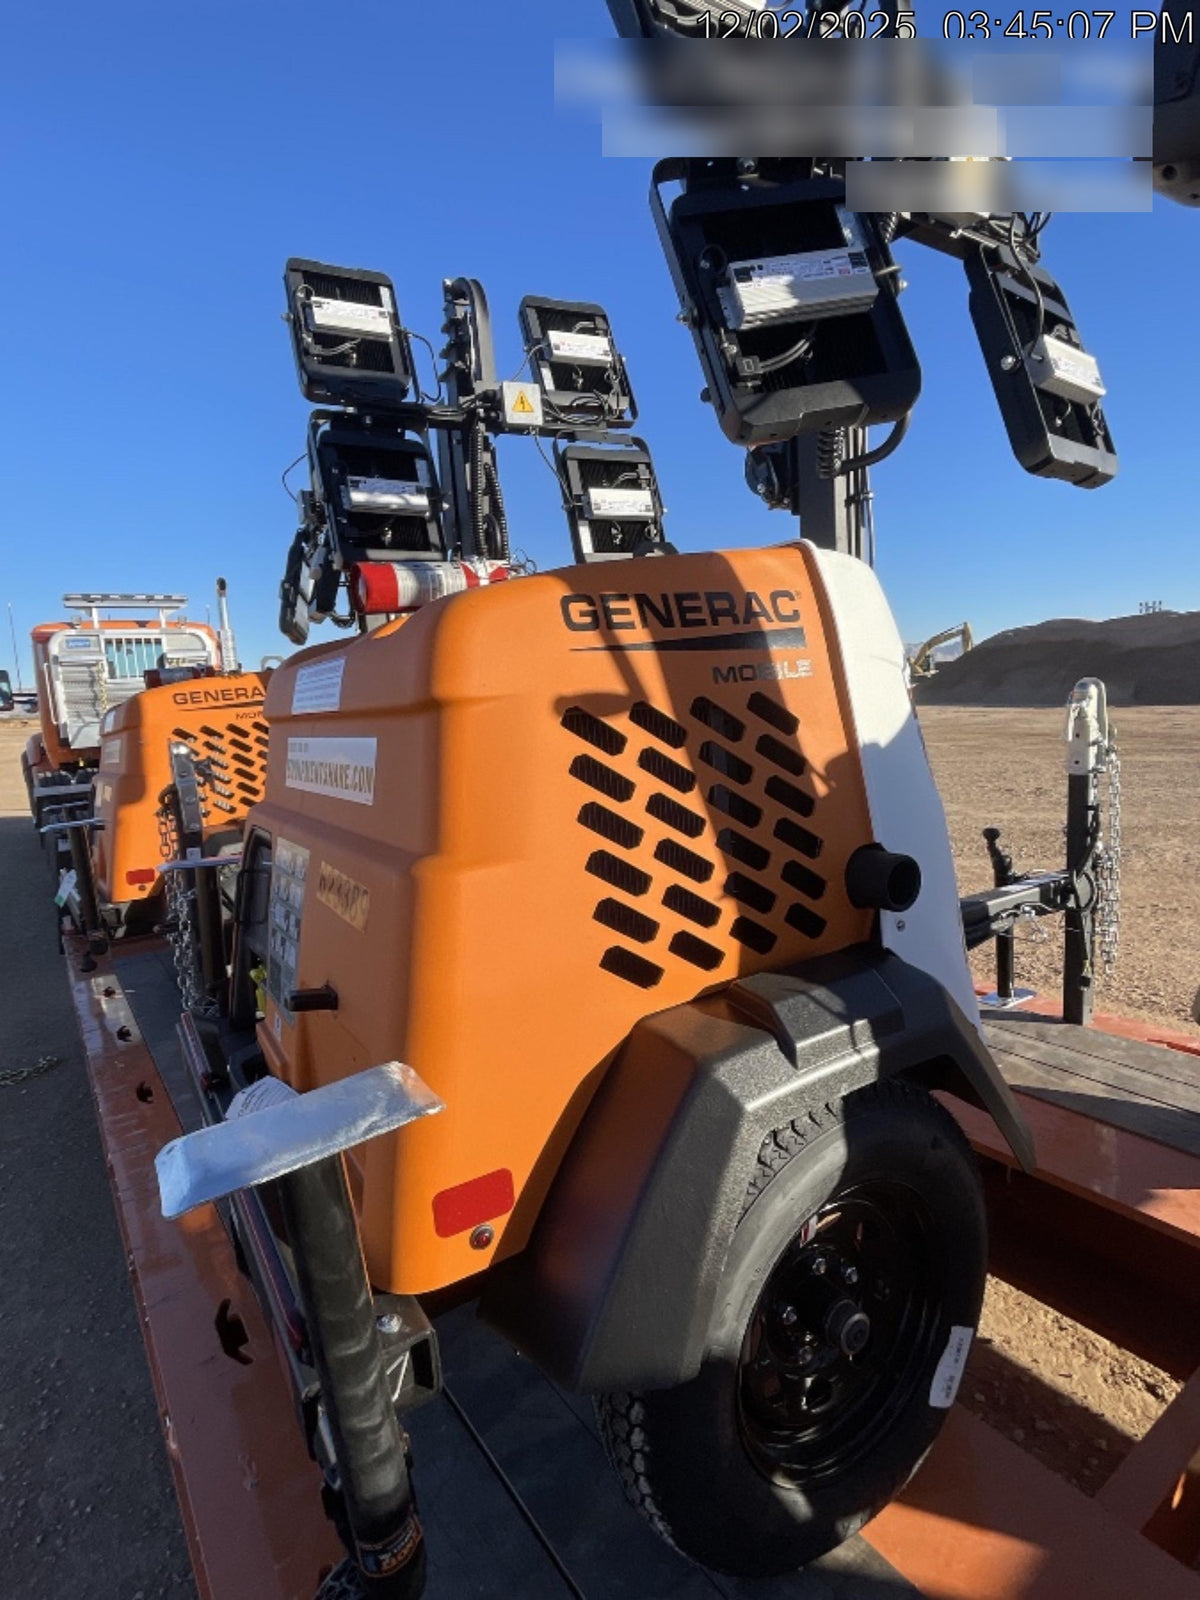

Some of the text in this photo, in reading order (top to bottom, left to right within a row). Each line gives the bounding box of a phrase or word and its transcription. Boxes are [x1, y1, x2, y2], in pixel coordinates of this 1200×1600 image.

[560, 590, 800, 632] GENERAC
[712, 658, 812, 684] MOBILE
[173, 686, 264, 705] GENERA
